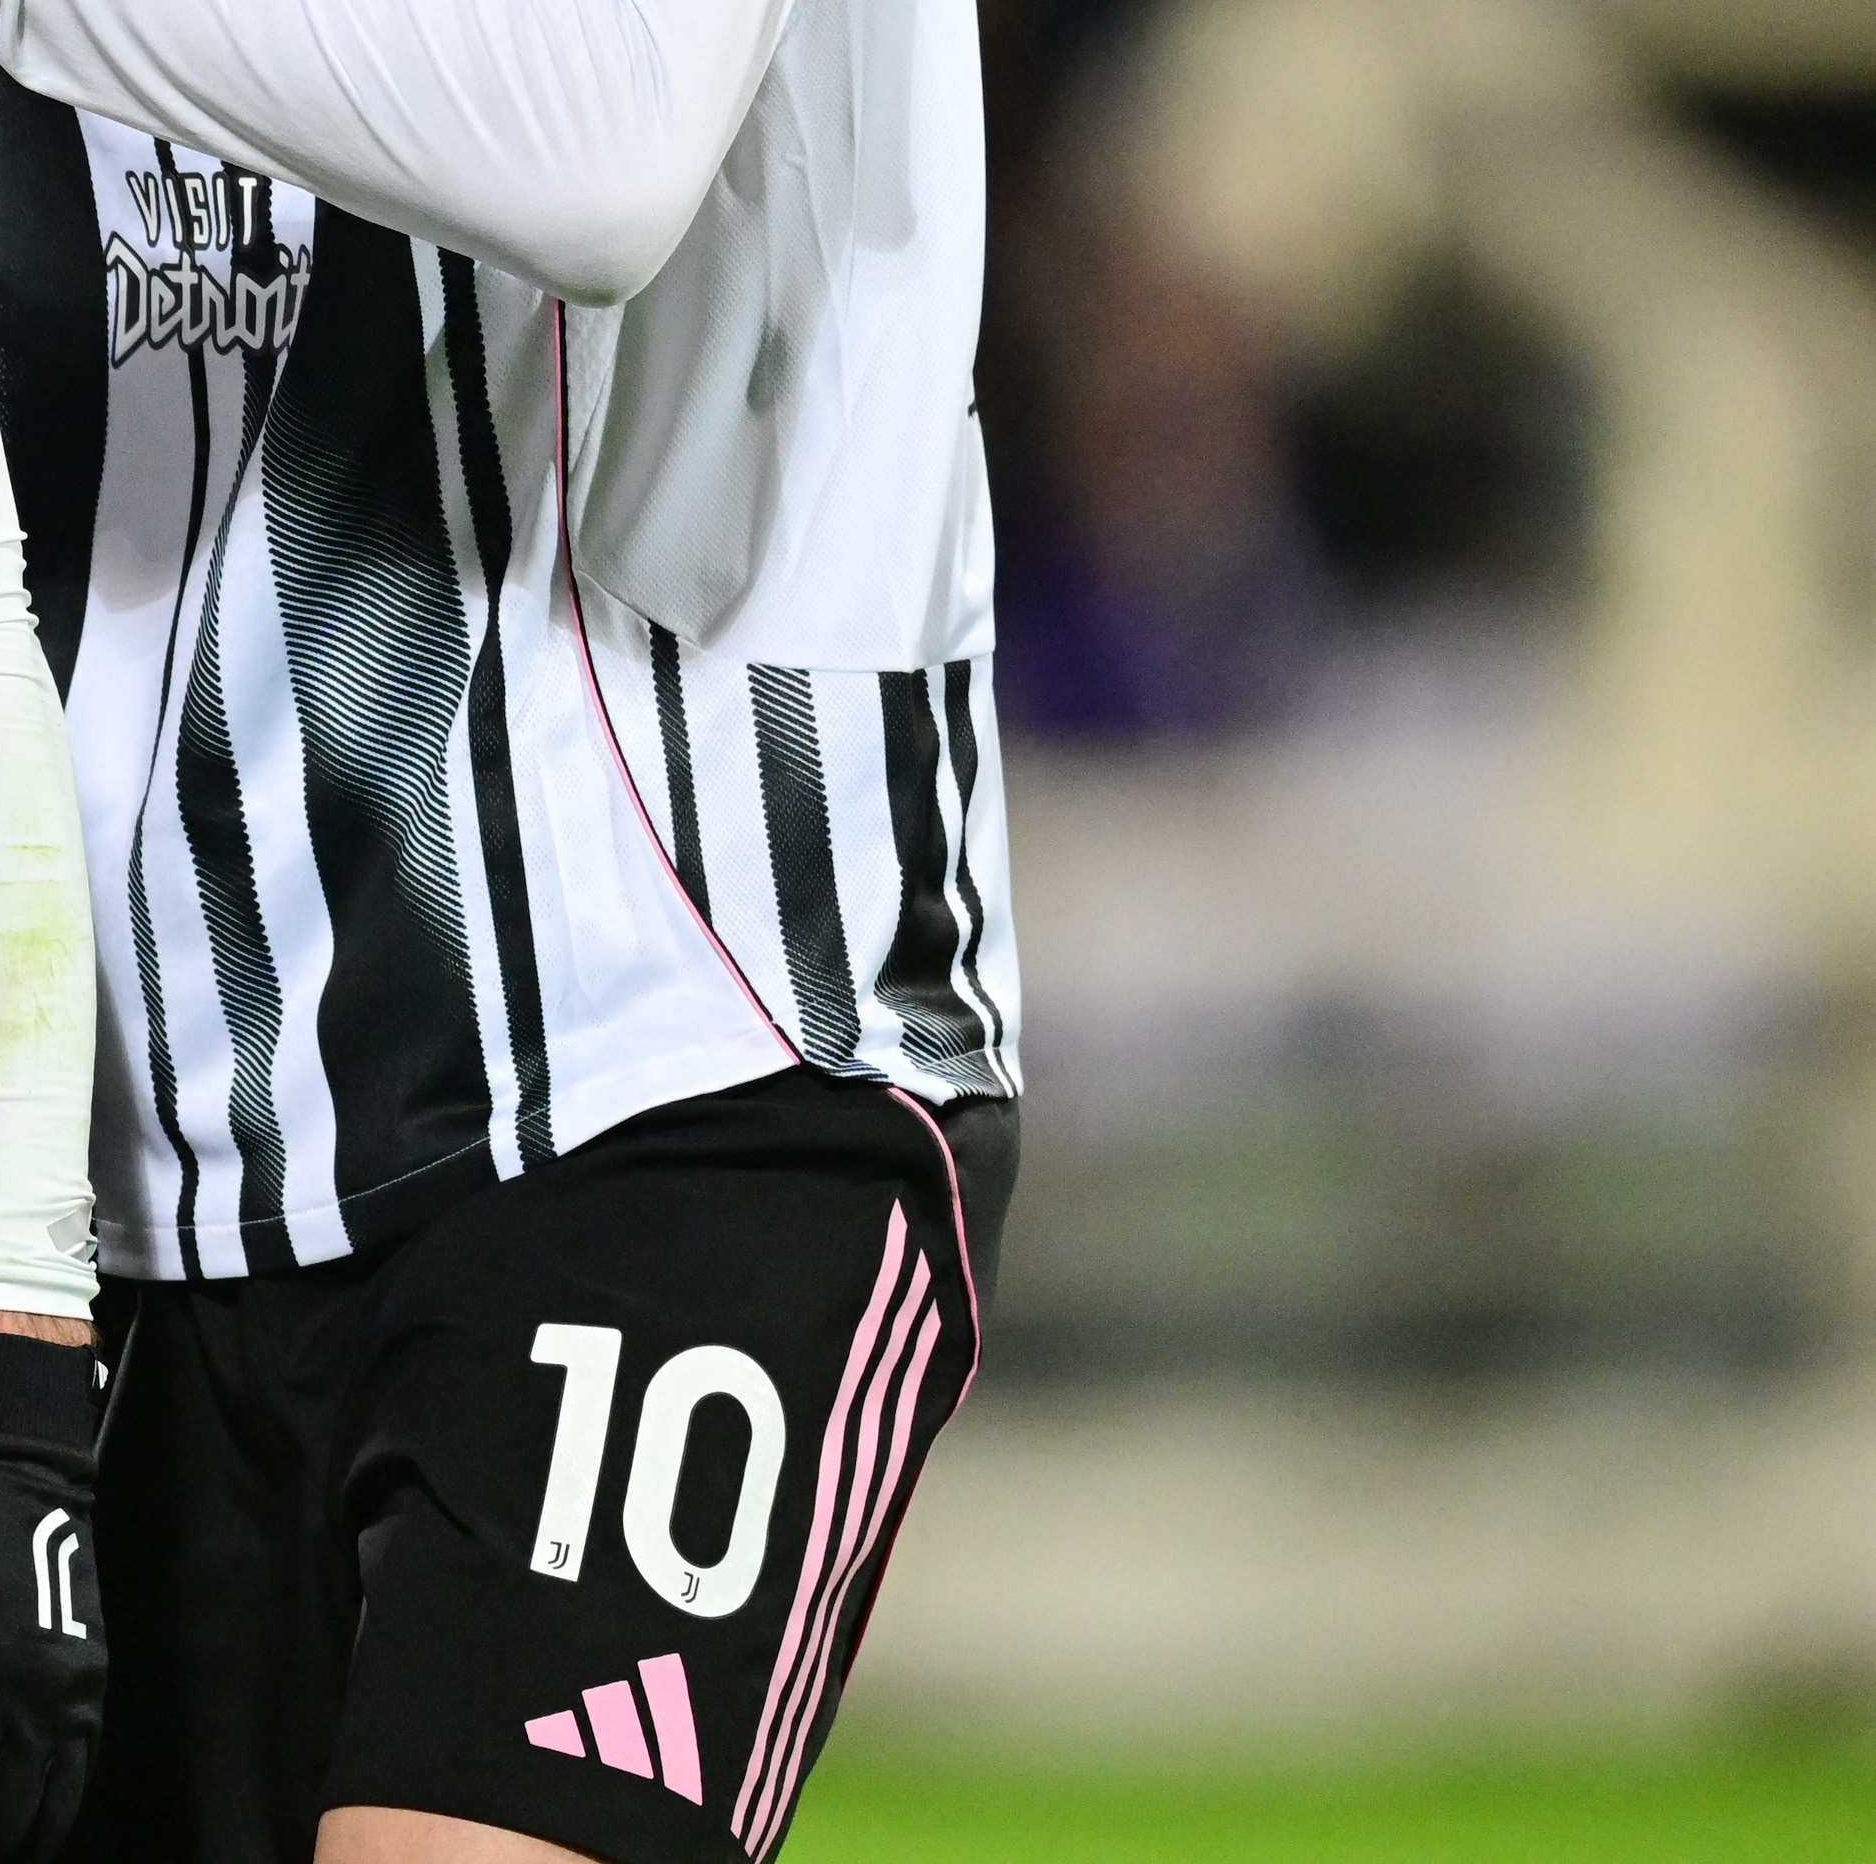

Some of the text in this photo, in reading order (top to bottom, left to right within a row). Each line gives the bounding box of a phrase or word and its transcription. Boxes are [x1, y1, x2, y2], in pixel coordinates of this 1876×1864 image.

[127, 175, 257, 246] VISIT
[105, 232, 311, 365] Detroit
[530, 1322, 787, 1618] 10
